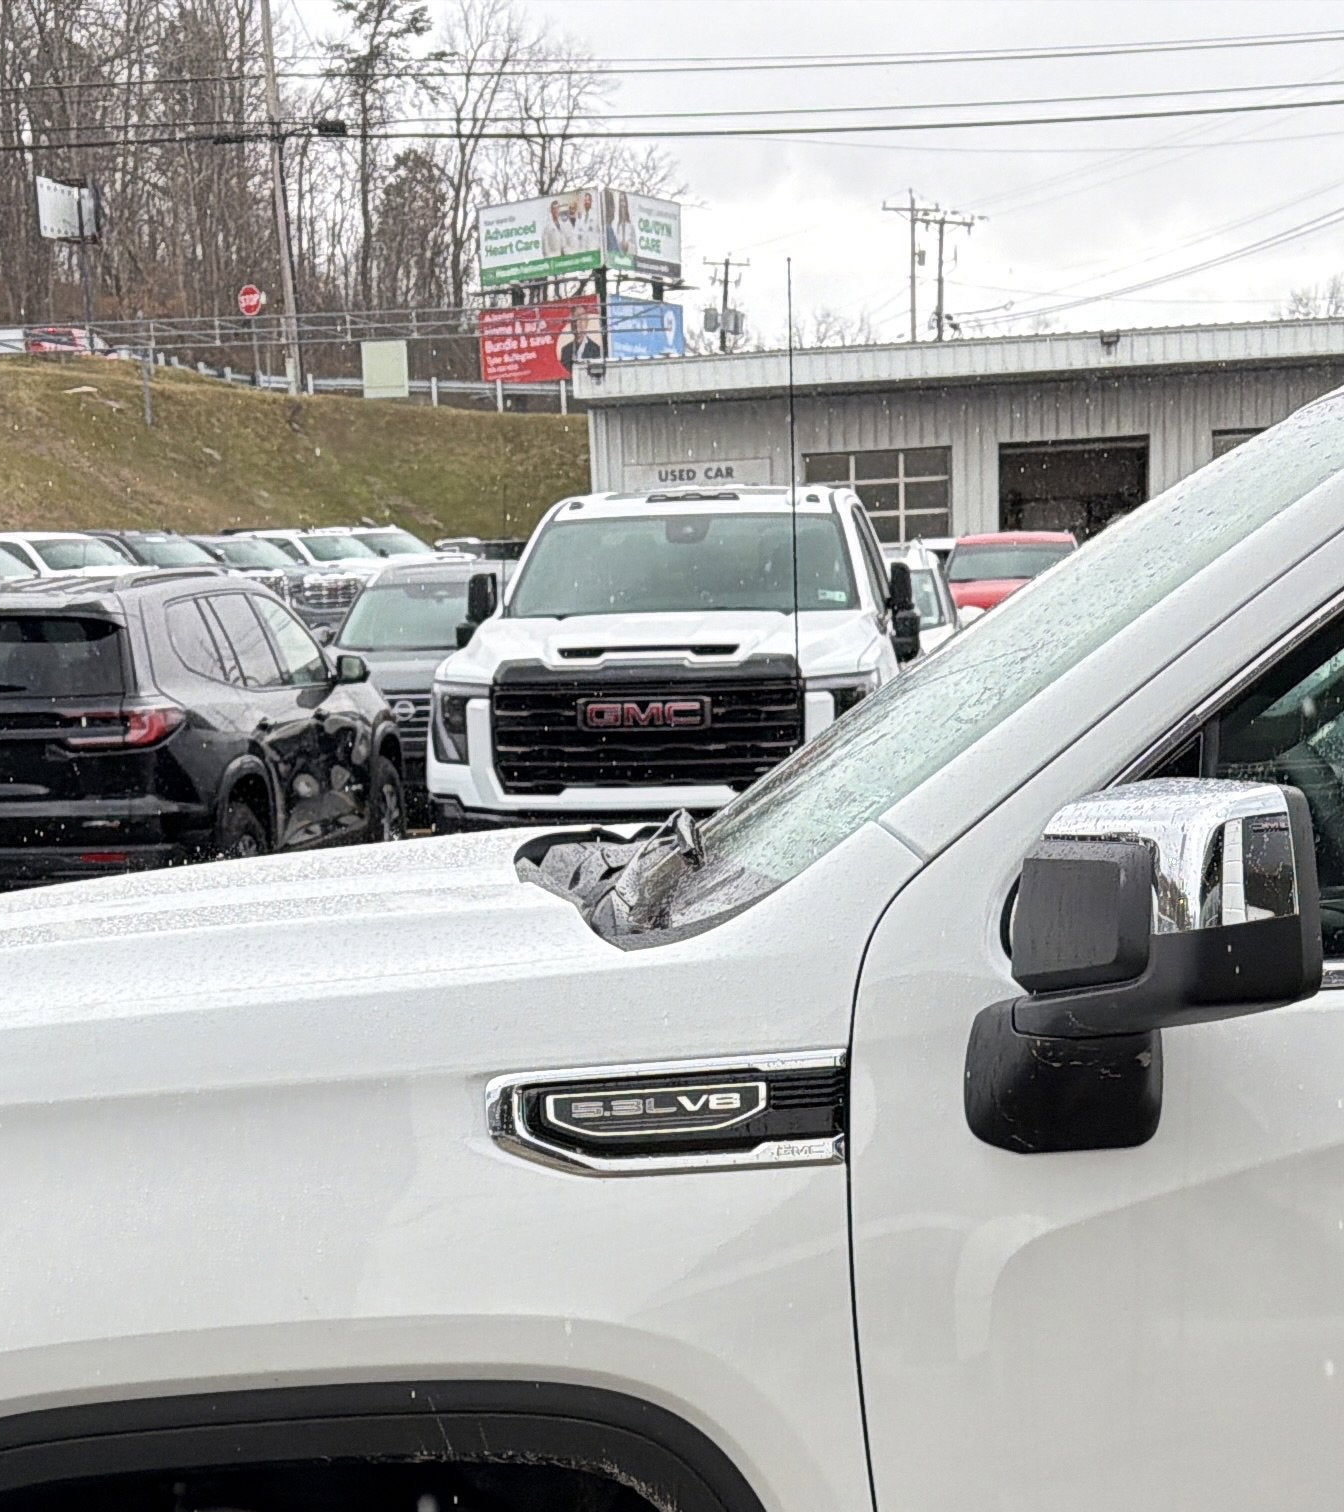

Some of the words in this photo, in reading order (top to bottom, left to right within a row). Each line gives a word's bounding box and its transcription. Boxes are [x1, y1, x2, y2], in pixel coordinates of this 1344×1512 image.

[485, 220, 536, 241] Advanced
[485, 242, 513, 257] Heart
[515, 240, 540, 252] Care
[658, 468, 697, 482] USED
[704, 466, 735, 480] CAR
[586, 700, 702, 727] GMC
